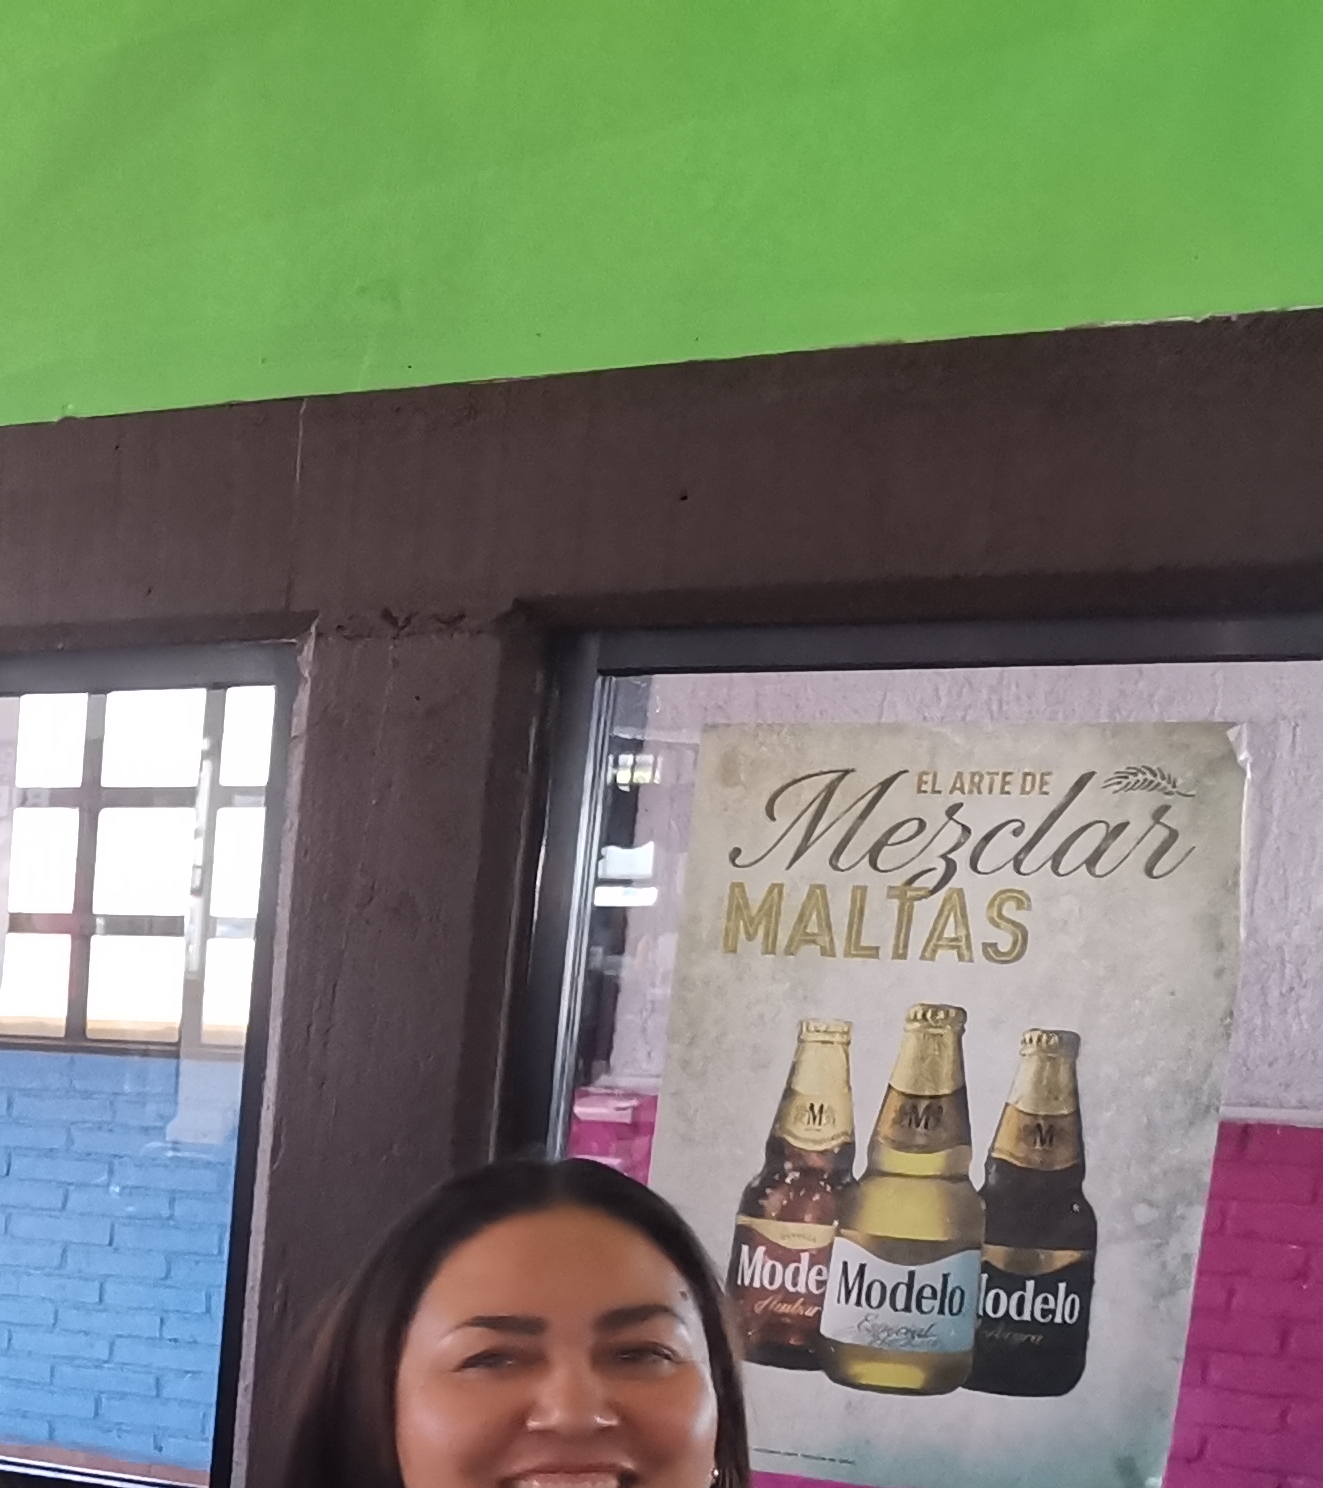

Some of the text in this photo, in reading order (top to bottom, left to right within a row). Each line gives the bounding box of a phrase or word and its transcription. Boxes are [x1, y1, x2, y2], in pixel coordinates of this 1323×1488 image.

[916, 770, 1053, 796] EL ARTE DE
[728, 767, 1197, 902] Mezclar
[721, 881, 1034, 965] MALTAS
[737, 1243, 829, 1295] Mode
[836, 1259, 966, 1317] Modelo
